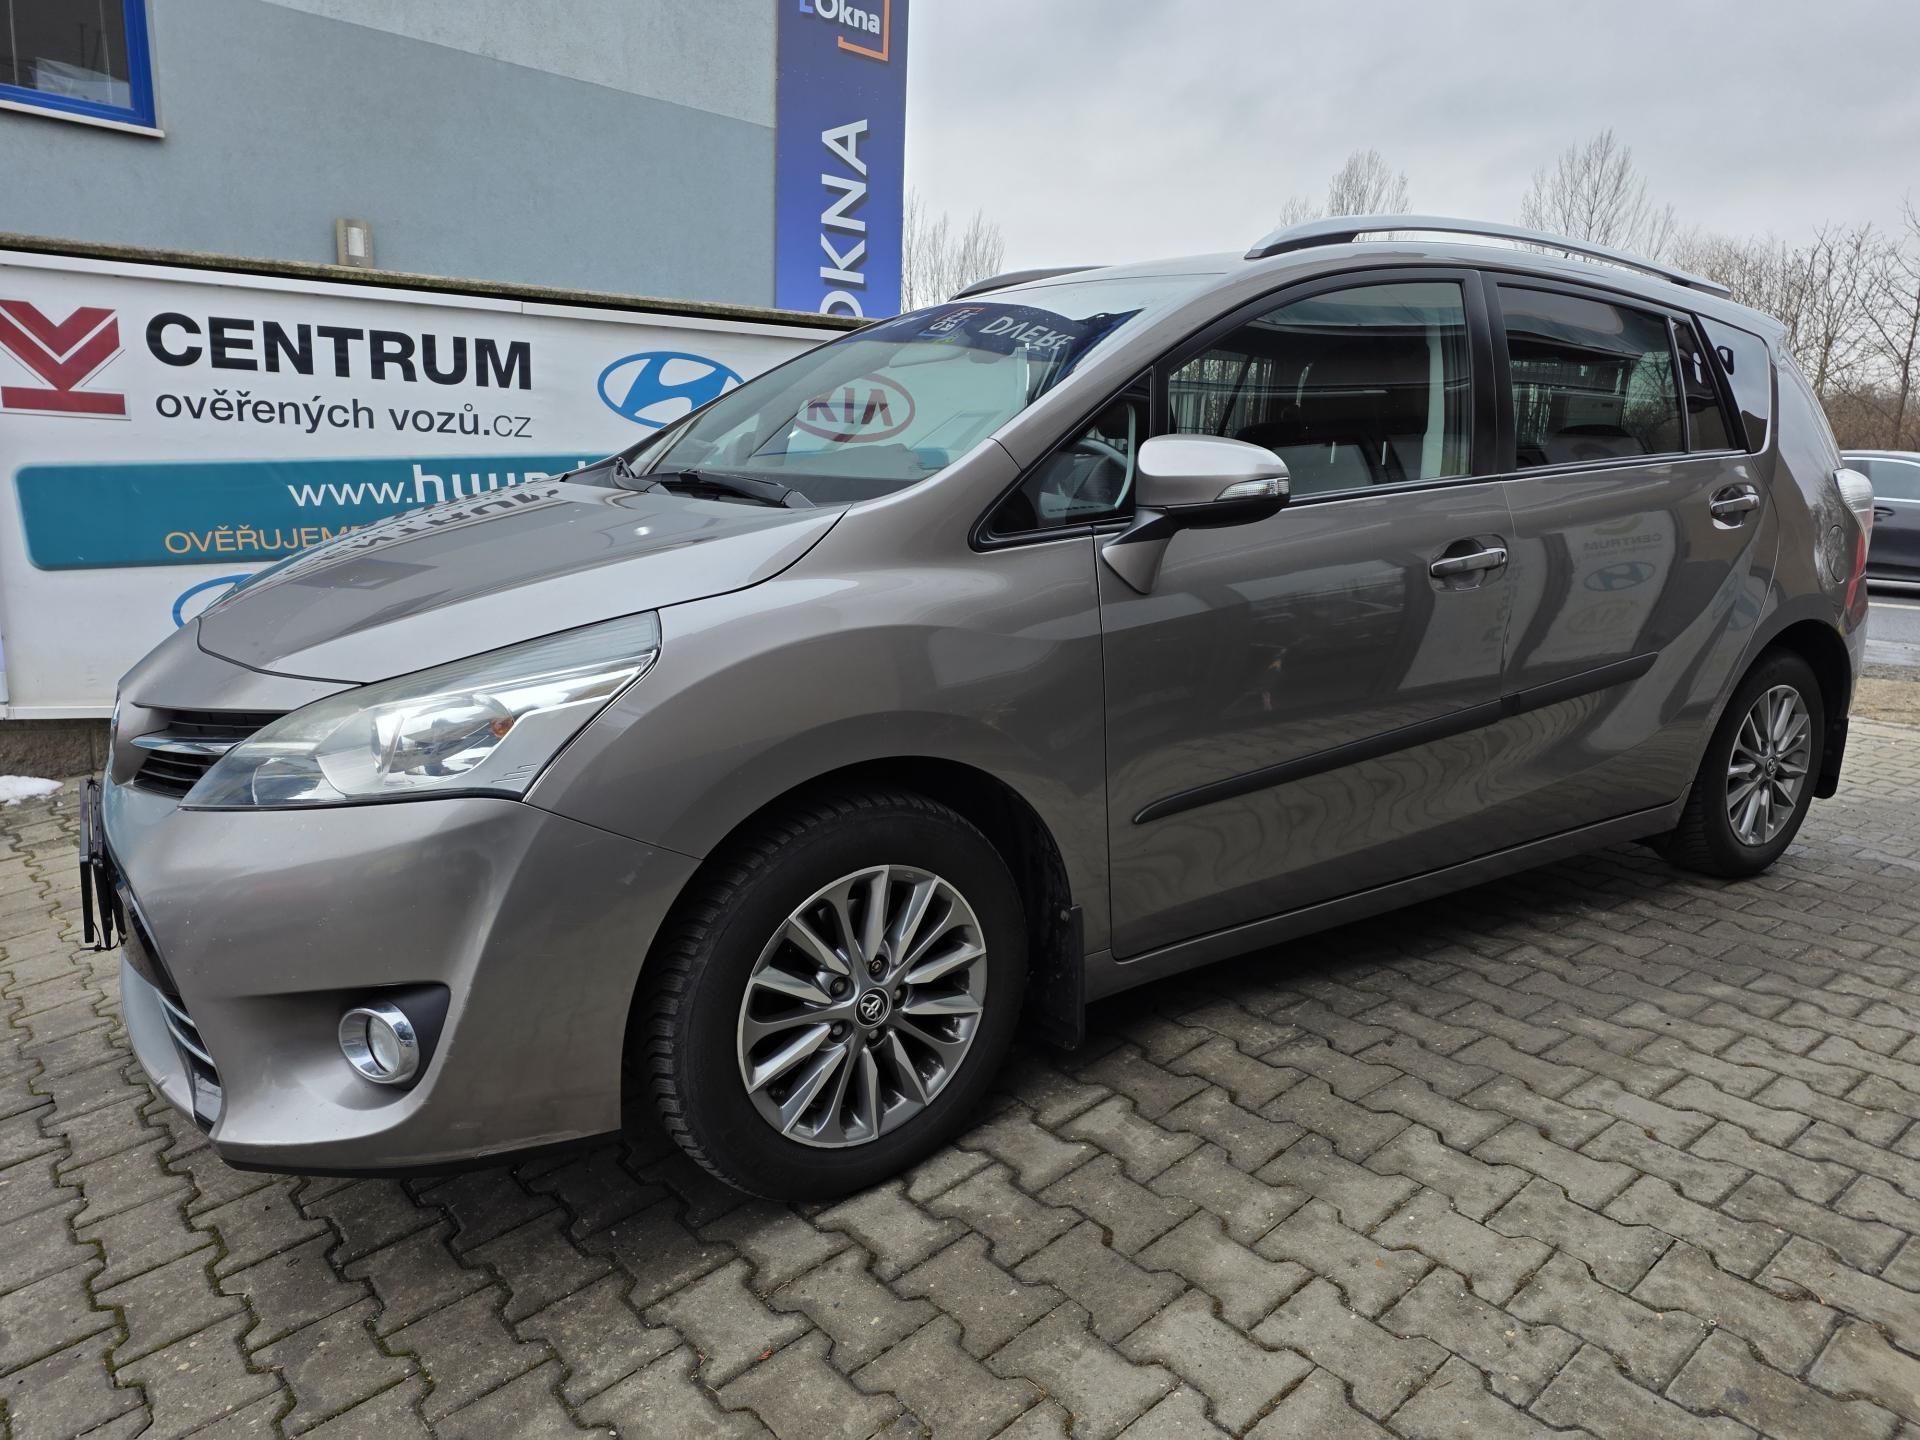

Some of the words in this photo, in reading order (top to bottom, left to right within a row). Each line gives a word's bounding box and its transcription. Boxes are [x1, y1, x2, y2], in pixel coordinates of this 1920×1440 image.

[815, 0, 880, 34] Okna
[146, 312, 532, 391] CENTRUM
[156, 389, 375, 434] ověřených
[806, 387, 894, 427] KIA
[165, 524, 361, 554] OVĚŘUJEM
